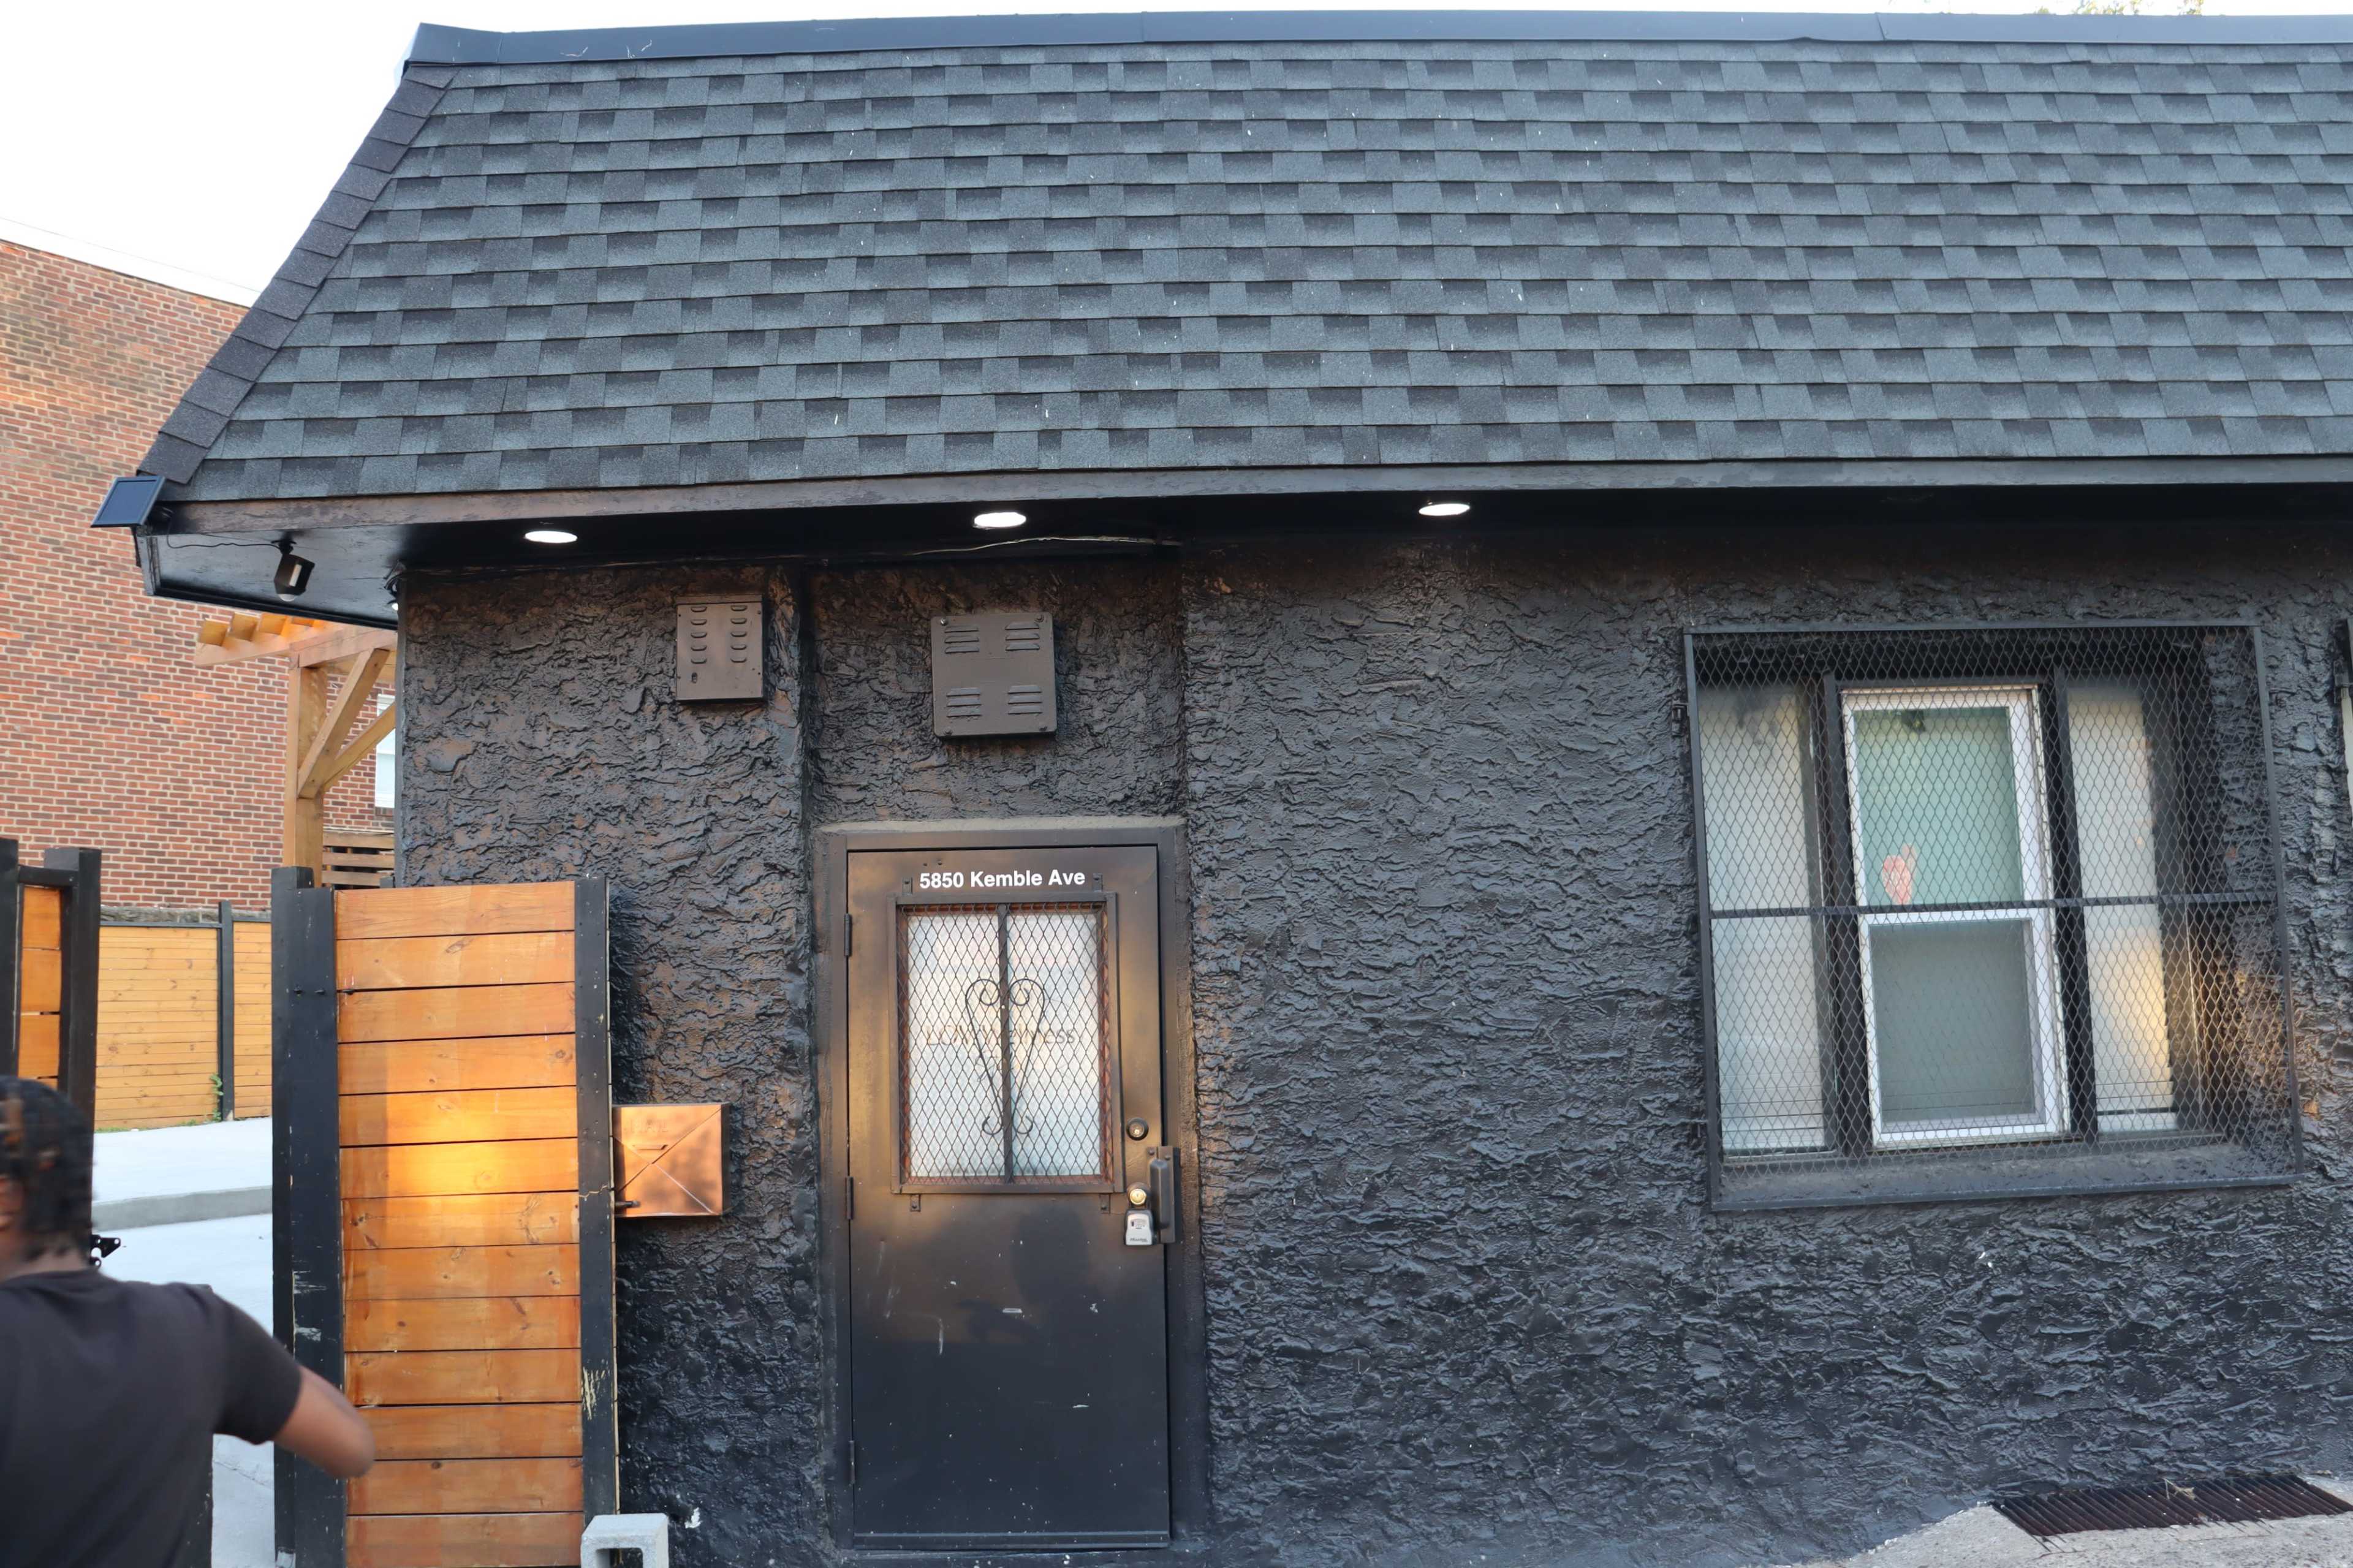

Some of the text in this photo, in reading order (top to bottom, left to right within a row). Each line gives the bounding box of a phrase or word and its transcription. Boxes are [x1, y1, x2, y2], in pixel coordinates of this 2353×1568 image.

[919, 869, 1085, 889] 5850 Kemble Ave
